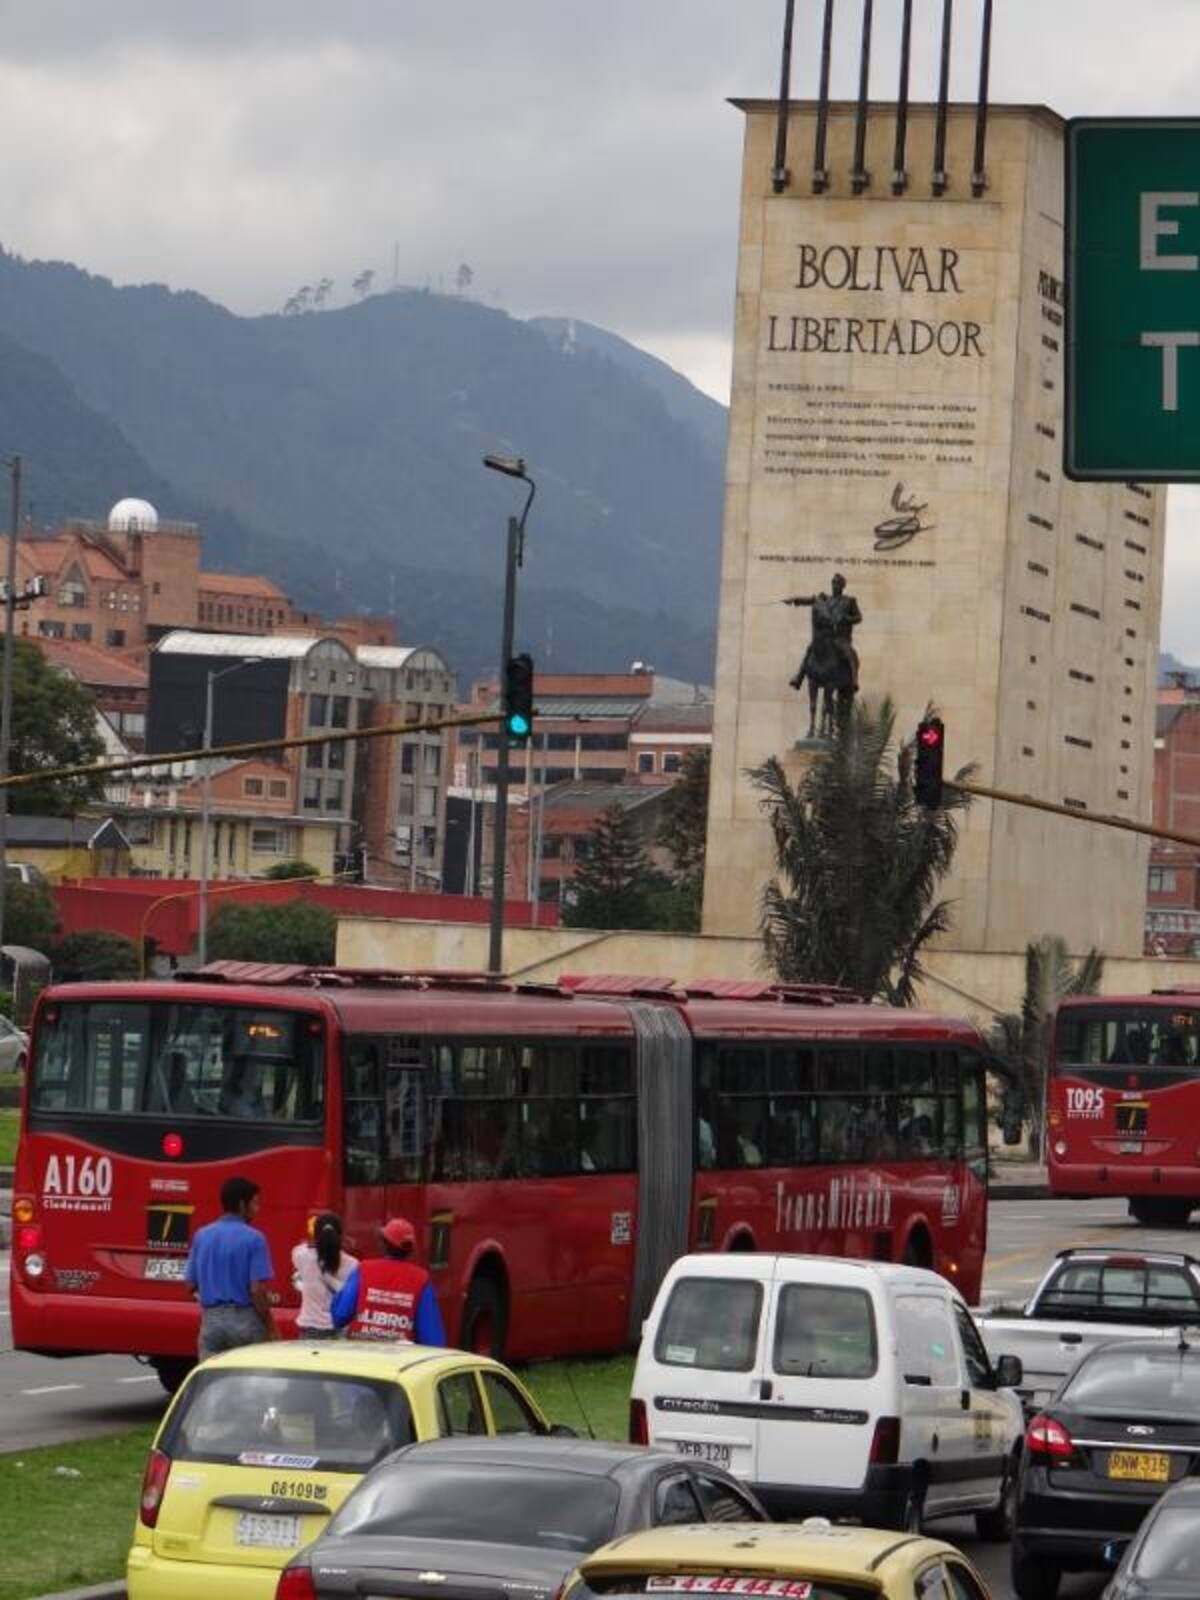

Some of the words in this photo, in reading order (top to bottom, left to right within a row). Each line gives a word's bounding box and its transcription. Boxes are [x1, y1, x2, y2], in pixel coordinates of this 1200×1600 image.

[1140, 191, 1199, 270] E
[795, 244, 964, 293] BOLIVAR
[768, 315, 986, 357] LIBERTADOR
[1140, 331, 1200, 411] T
[1066, 1087, 1105, 1110] T095
[43, 1154, 113, 1196] A160
[271, 1481, 313, 1498] 08109
